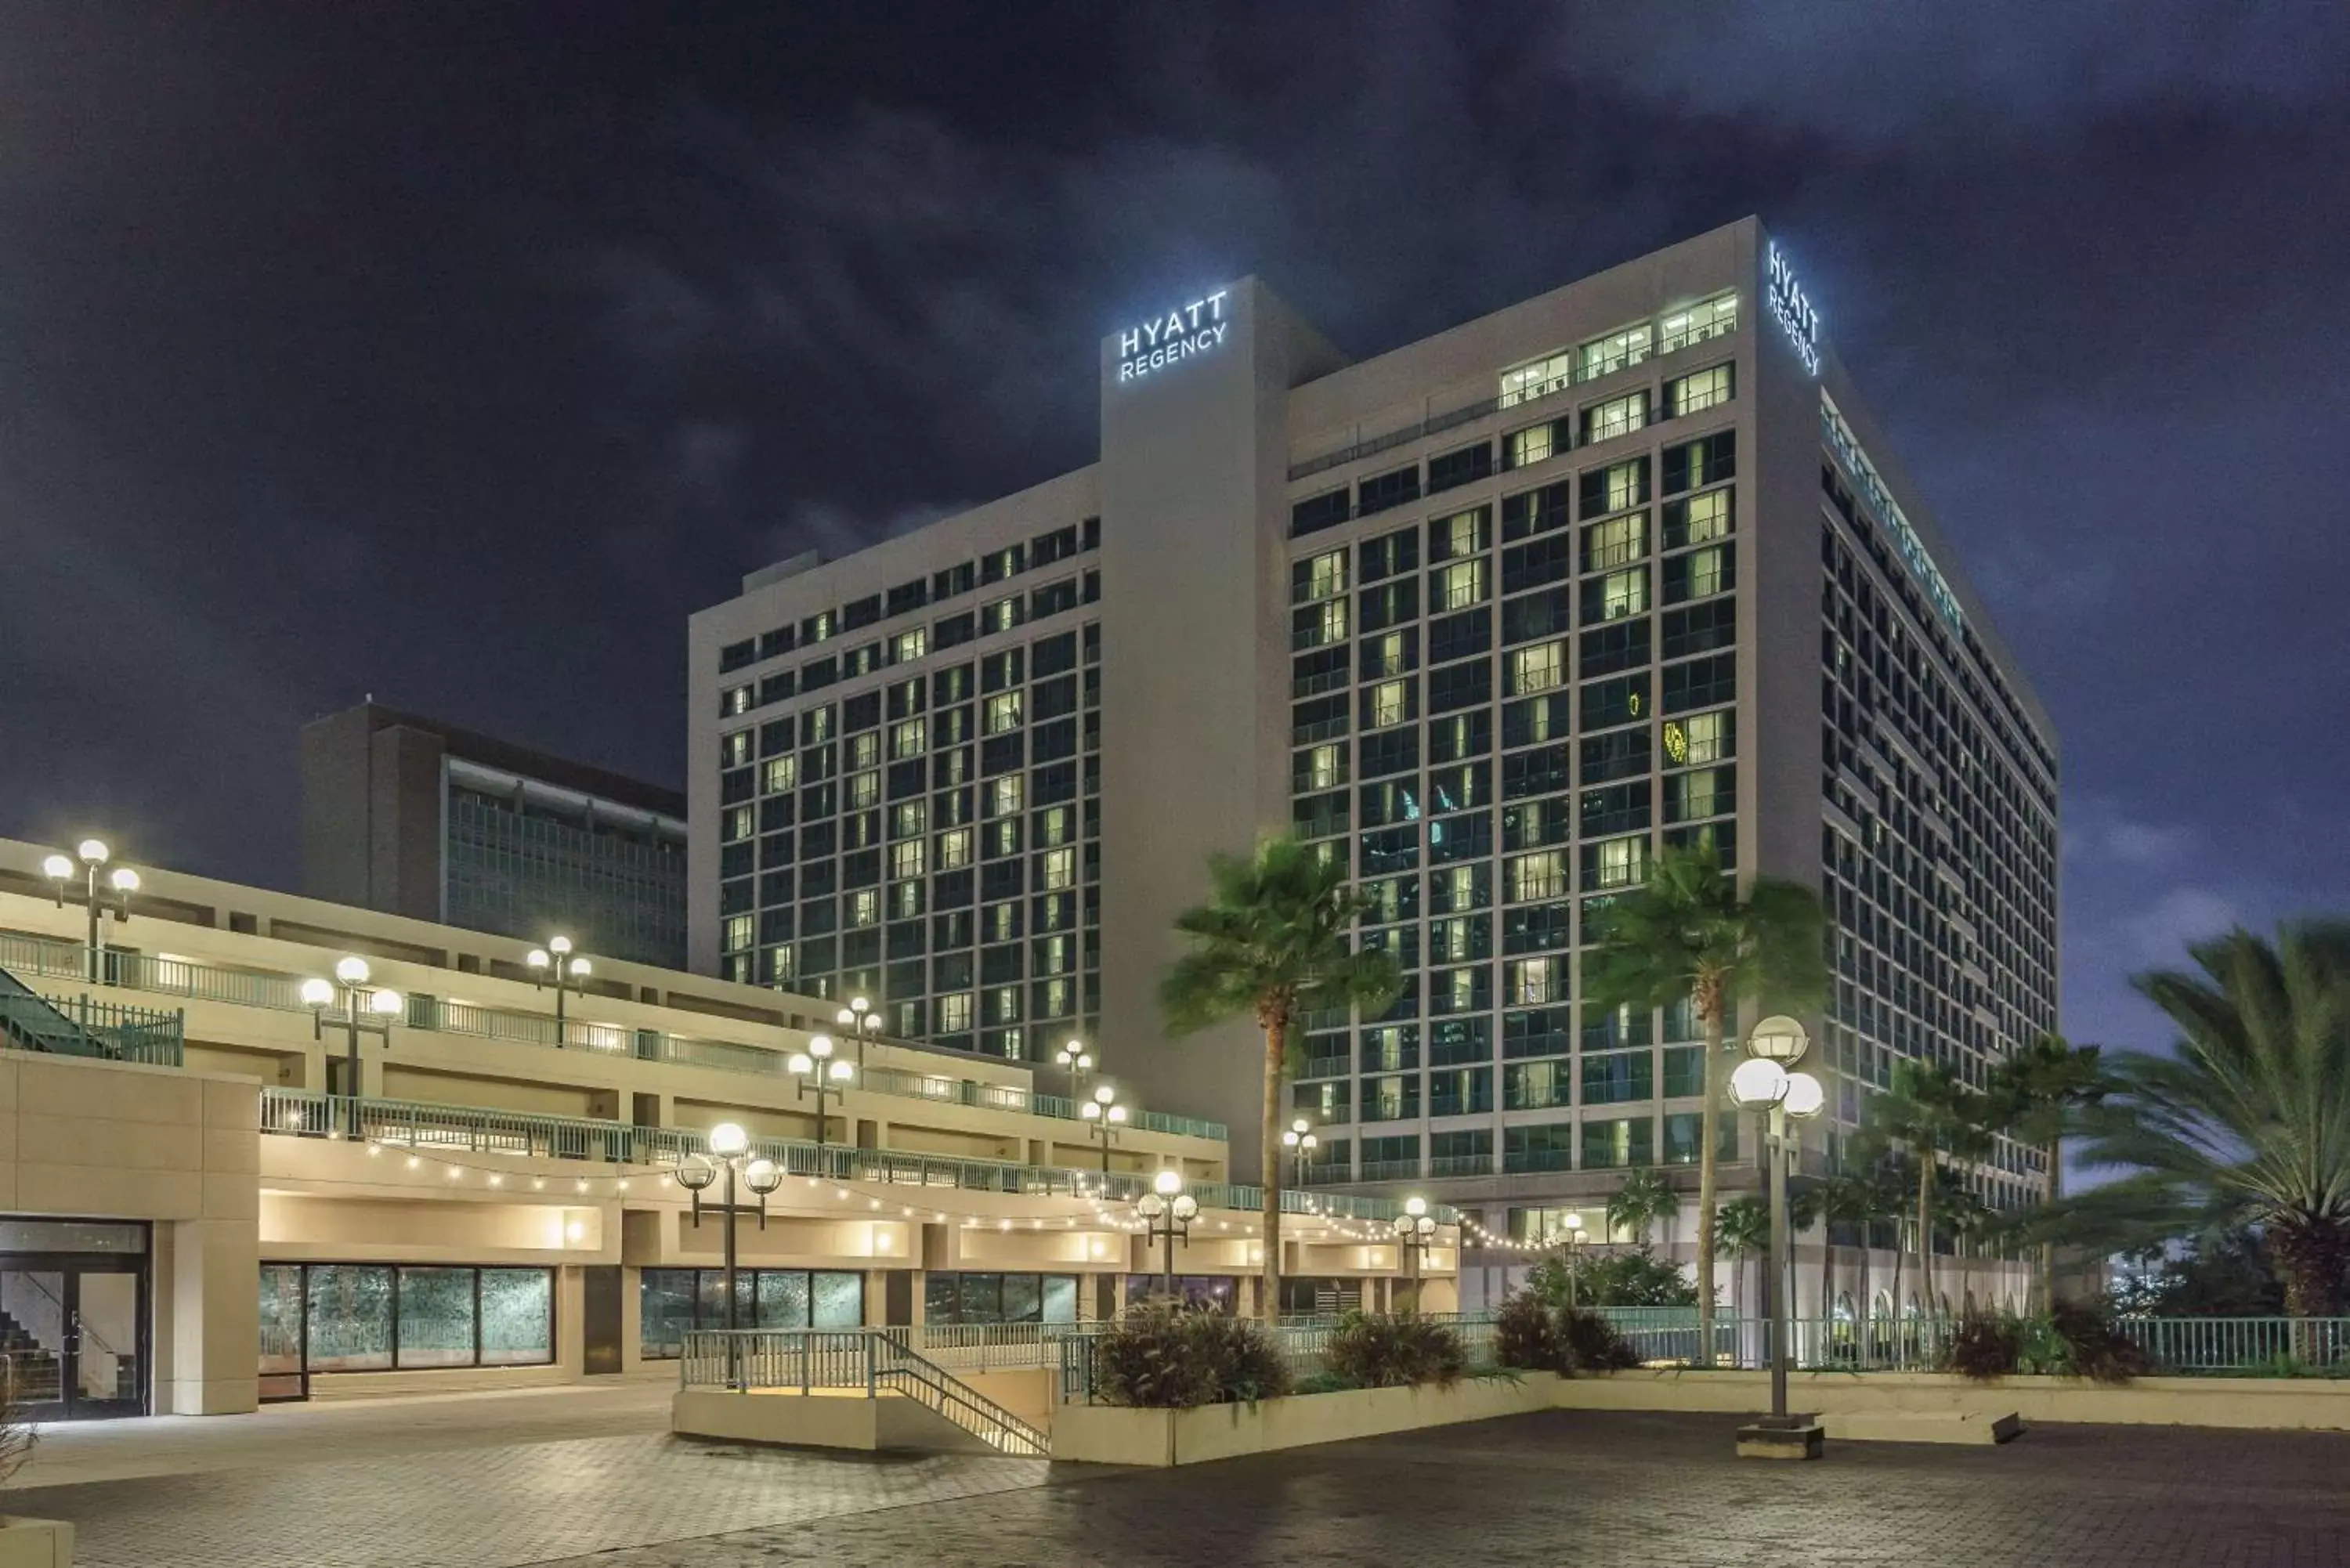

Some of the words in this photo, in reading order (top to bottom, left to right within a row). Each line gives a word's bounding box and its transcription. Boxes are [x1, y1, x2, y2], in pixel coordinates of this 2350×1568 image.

[1121, 291, 1227, 357] HYATT
[1769, 284, 1818, 377] REGENCY
[1770, 240, 1818, 343] HYATT
[1120, 322, 1227, 382] REGENCY
